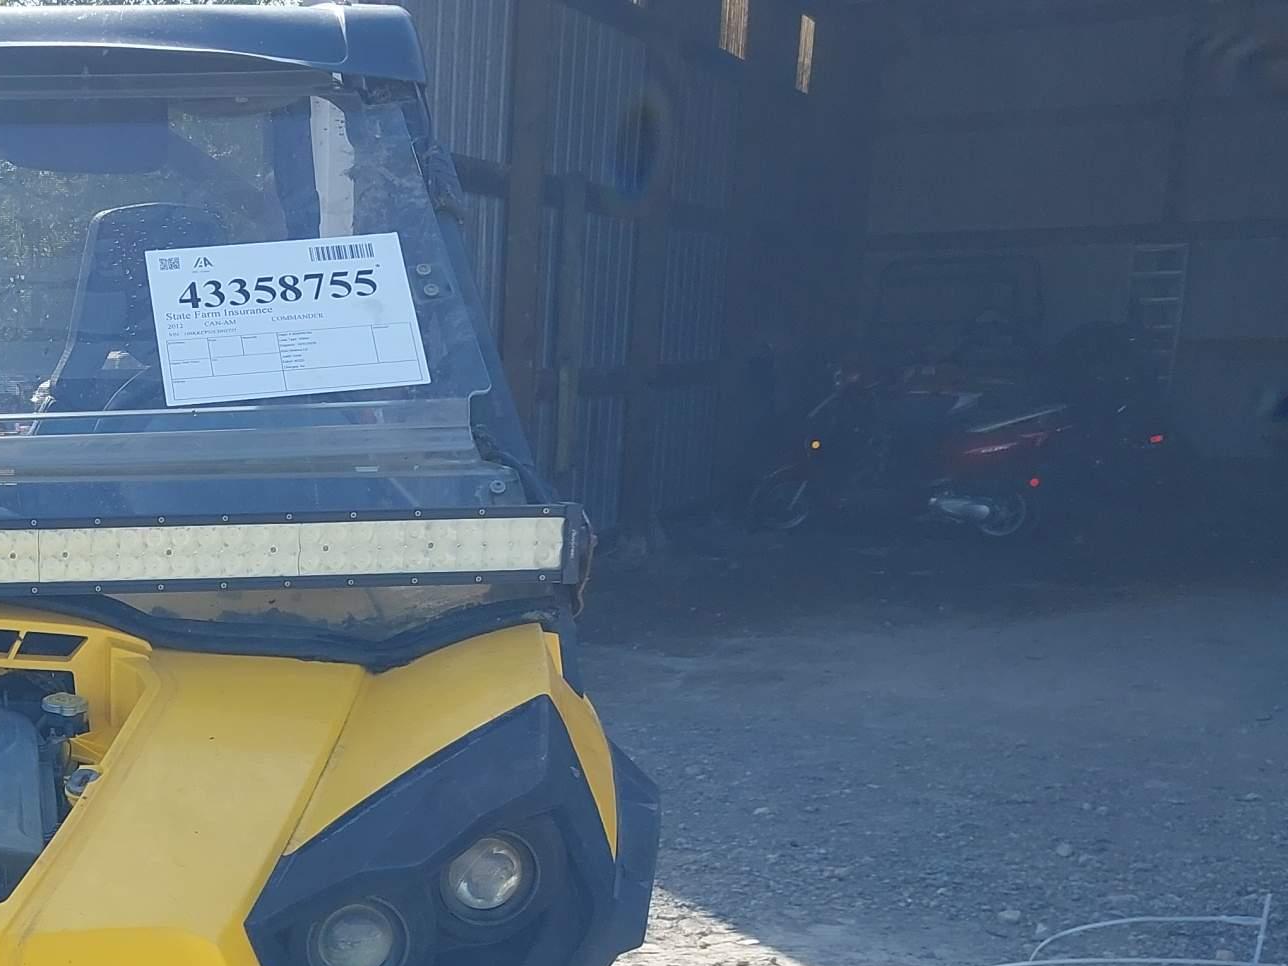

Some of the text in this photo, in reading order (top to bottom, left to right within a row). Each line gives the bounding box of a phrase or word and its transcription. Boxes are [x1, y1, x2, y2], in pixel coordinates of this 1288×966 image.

[178, 269, 378, 309] 43358755
[165, 307, 273, 321] State Farm Insurance
